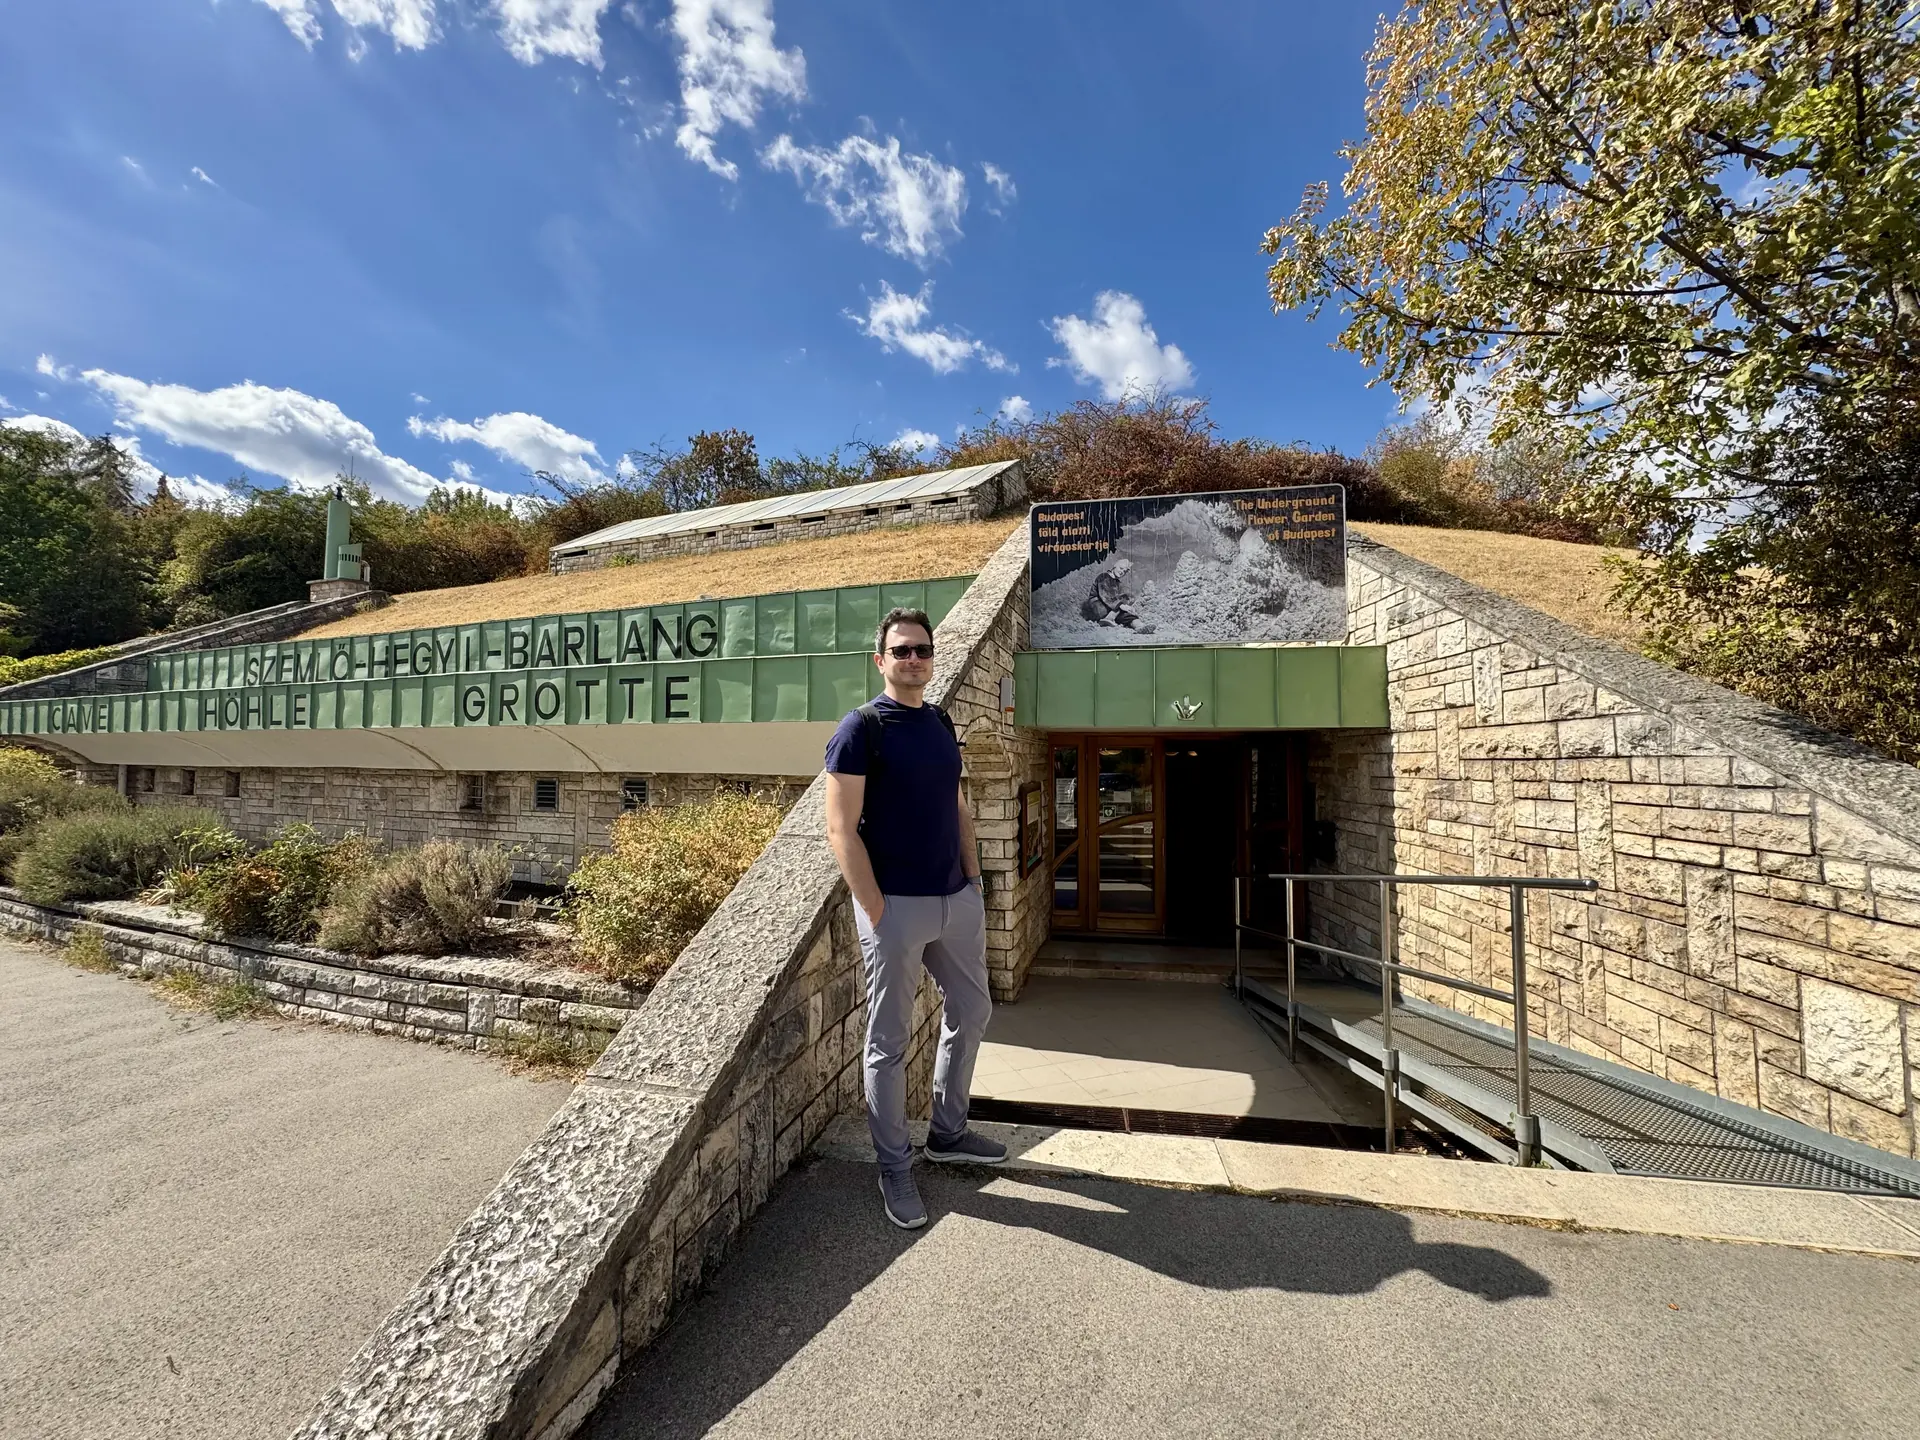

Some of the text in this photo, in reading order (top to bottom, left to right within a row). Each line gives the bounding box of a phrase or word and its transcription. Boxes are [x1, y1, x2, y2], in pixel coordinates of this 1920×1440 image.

[1233, 495, 1335, 511] The Underground
[1038, 511, 1085, 523] Budapest
[1247, 511, 1335, 525] Flower Garden
[1038, 525, 1091, 538] föld alatti
[1267, 528, 1336, 541] of Budapest
[462, 675, 691, 722] GROTTE
[51, 704, 107, 731] CAVE
[204, 694, 307, 727] HÖHLE
